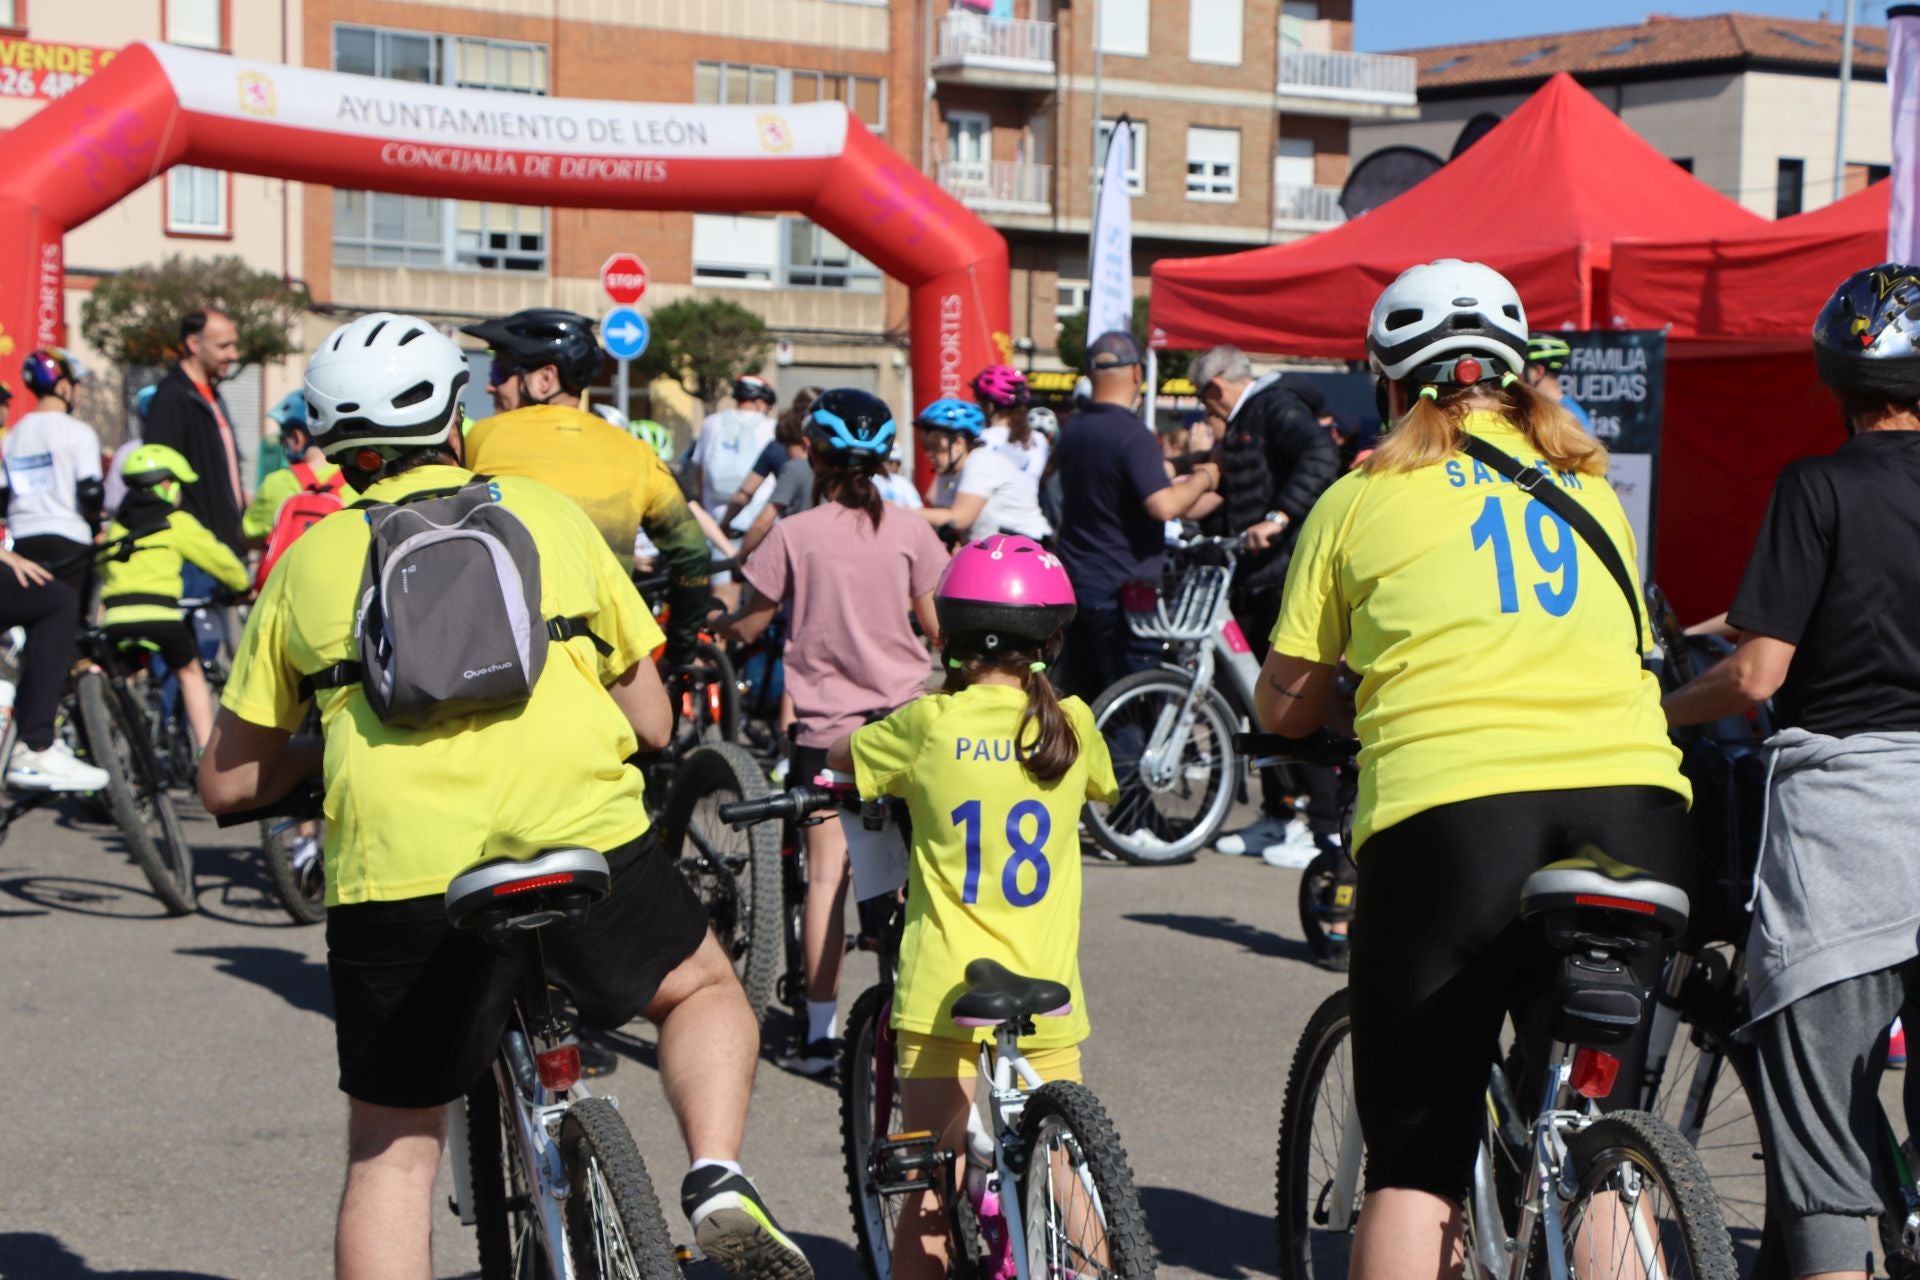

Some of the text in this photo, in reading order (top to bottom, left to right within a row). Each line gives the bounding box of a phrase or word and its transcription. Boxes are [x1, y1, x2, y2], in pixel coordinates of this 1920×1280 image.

[0, 66, 36, 97] 26
[337, 95, 708, 146] AYUNTAMIENTO DE LEÓN
[381, 142, 668, 183] CONCEJALÍA DE DEPORTES
[37, 243, 60, 349] PORTES
[607, 273, 643, 289] STOP
[1570, 347, 1648, 371] FAMILIA
[1470, 495, 1579, 618] 19
[956, 736, 1043, 762] PAU
[951, 799, 1052, 908] 18
